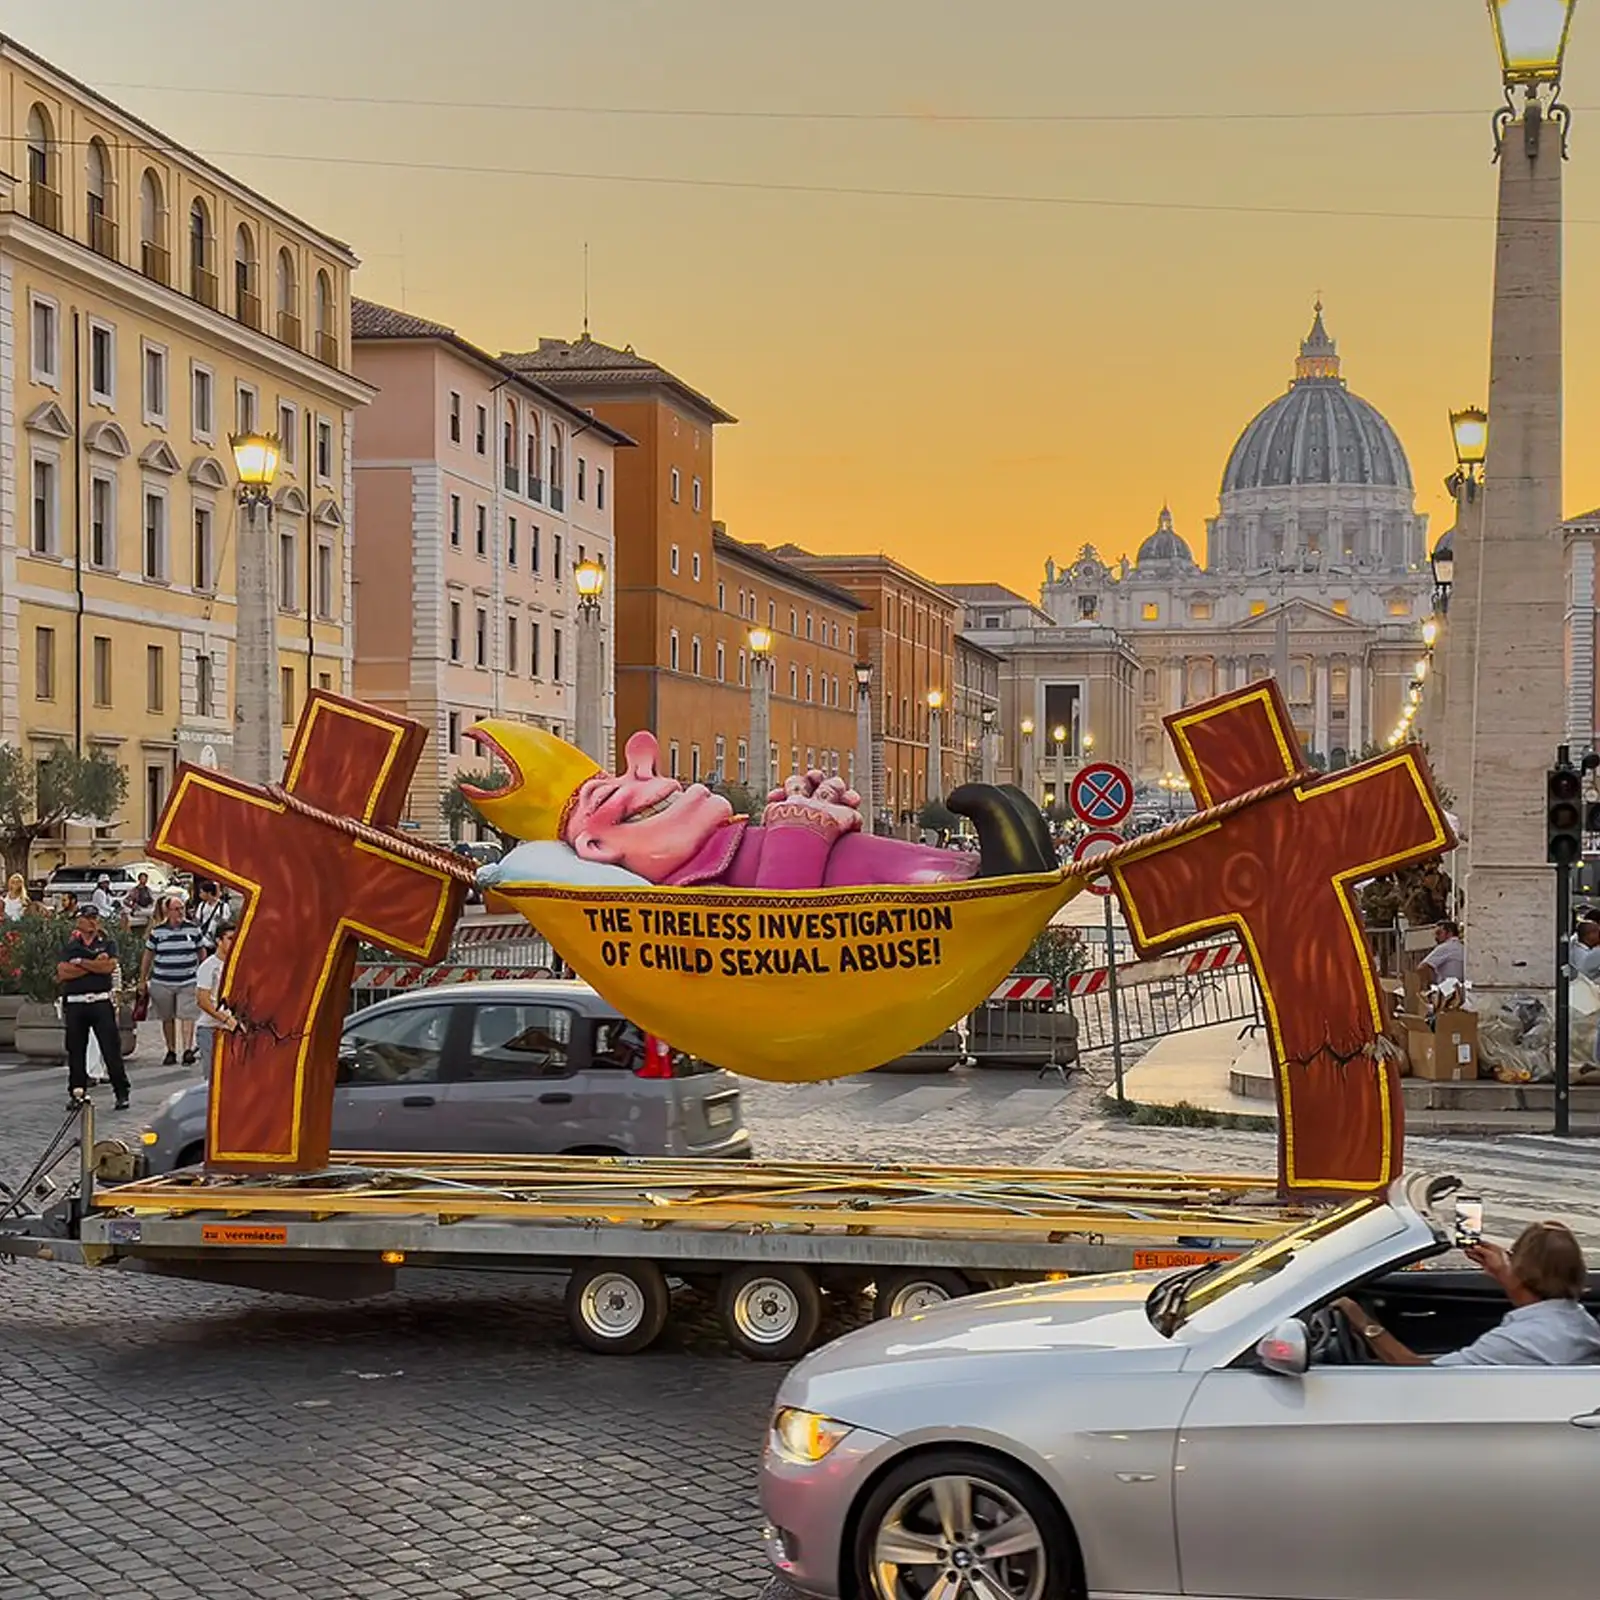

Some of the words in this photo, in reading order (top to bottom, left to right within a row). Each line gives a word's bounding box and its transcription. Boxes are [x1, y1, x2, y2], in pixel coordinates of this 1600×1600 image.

[583, 907, 633, 933] THE
[638, 909, 753, 942] TIRELESS
[757, 905, 953, 940] INVESTIGATION
[601, 940, 631, 967] OF
[639, 943, 714, 974] CHILD
[720, 948, 830, 976] SEXUAL
[839, 937, 942, 973] ABUSE!
[203, 1231, 219, 1240] zu
[224, 1230, 285, 1241] vermieten
